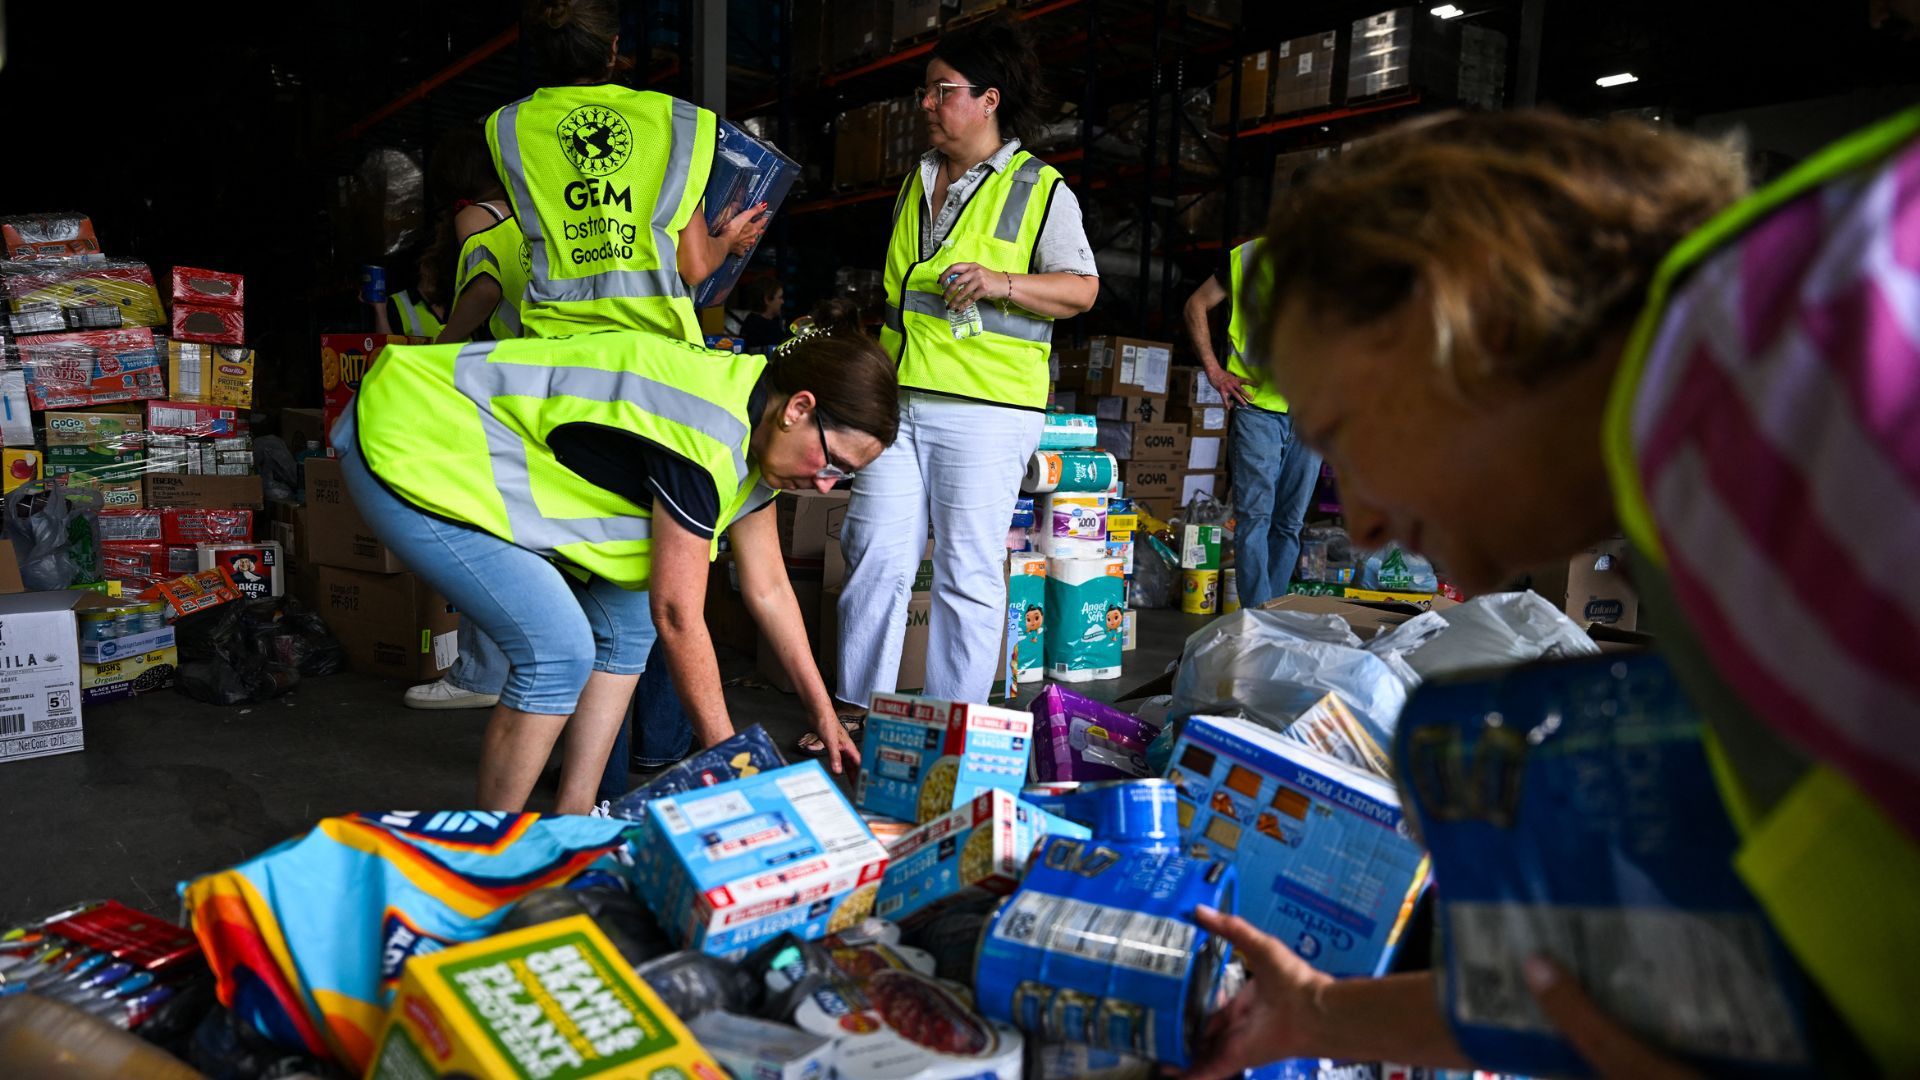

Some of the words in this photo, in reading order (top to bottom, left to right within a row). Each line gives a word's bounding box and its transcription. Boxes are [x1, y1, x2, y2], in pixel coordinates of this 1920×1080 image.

[564, 178, 632, 213] GEM
[563, 216, 636, 244] bstrong
[571, 241, 633, 264] Good360
[220, 365, 245, 375] Barilla
[340, 353, 367, 383] RITZ
[36, 366, 87, 383] NOODLES
[217, 377, 244, 386] PROTEIN
[51, 418, 80, 430] GoGo
[1145, 436, 1175, 448] GOYA
[152, 477, 184, 486] IBERIA
[1137, 473, 1167, 486] GOYA
[110, 493, 137, 504] GoGo
[1078, 517, 1096, 527] 1000
[1380, 575, 1414, 583] DOLLAR
[235, 583, 266, 592] AKER
[1081, 600, 1107, 615] Angel
[1087, 611, 1104, 624] Soft
[0, 653, 37, 669] ILA
[96, 663, 121, 674] BUSH'S
[94, 674, 124, 684] Organic
[90, 686, 110, 694] BLACK
[111, 683, 129, 691] BEANS
[50, 697, 60, 708] 5
[18, 740, 30, 751] Net
[1296, 770, 1334, 796] PACK
[1279, 902, 1353, 952] Gerber
[546, 943, 633, 1028] BEANS
[521, 951, 618, 1056] GRAINS
[472, 960, 585, 1070] PLANT
